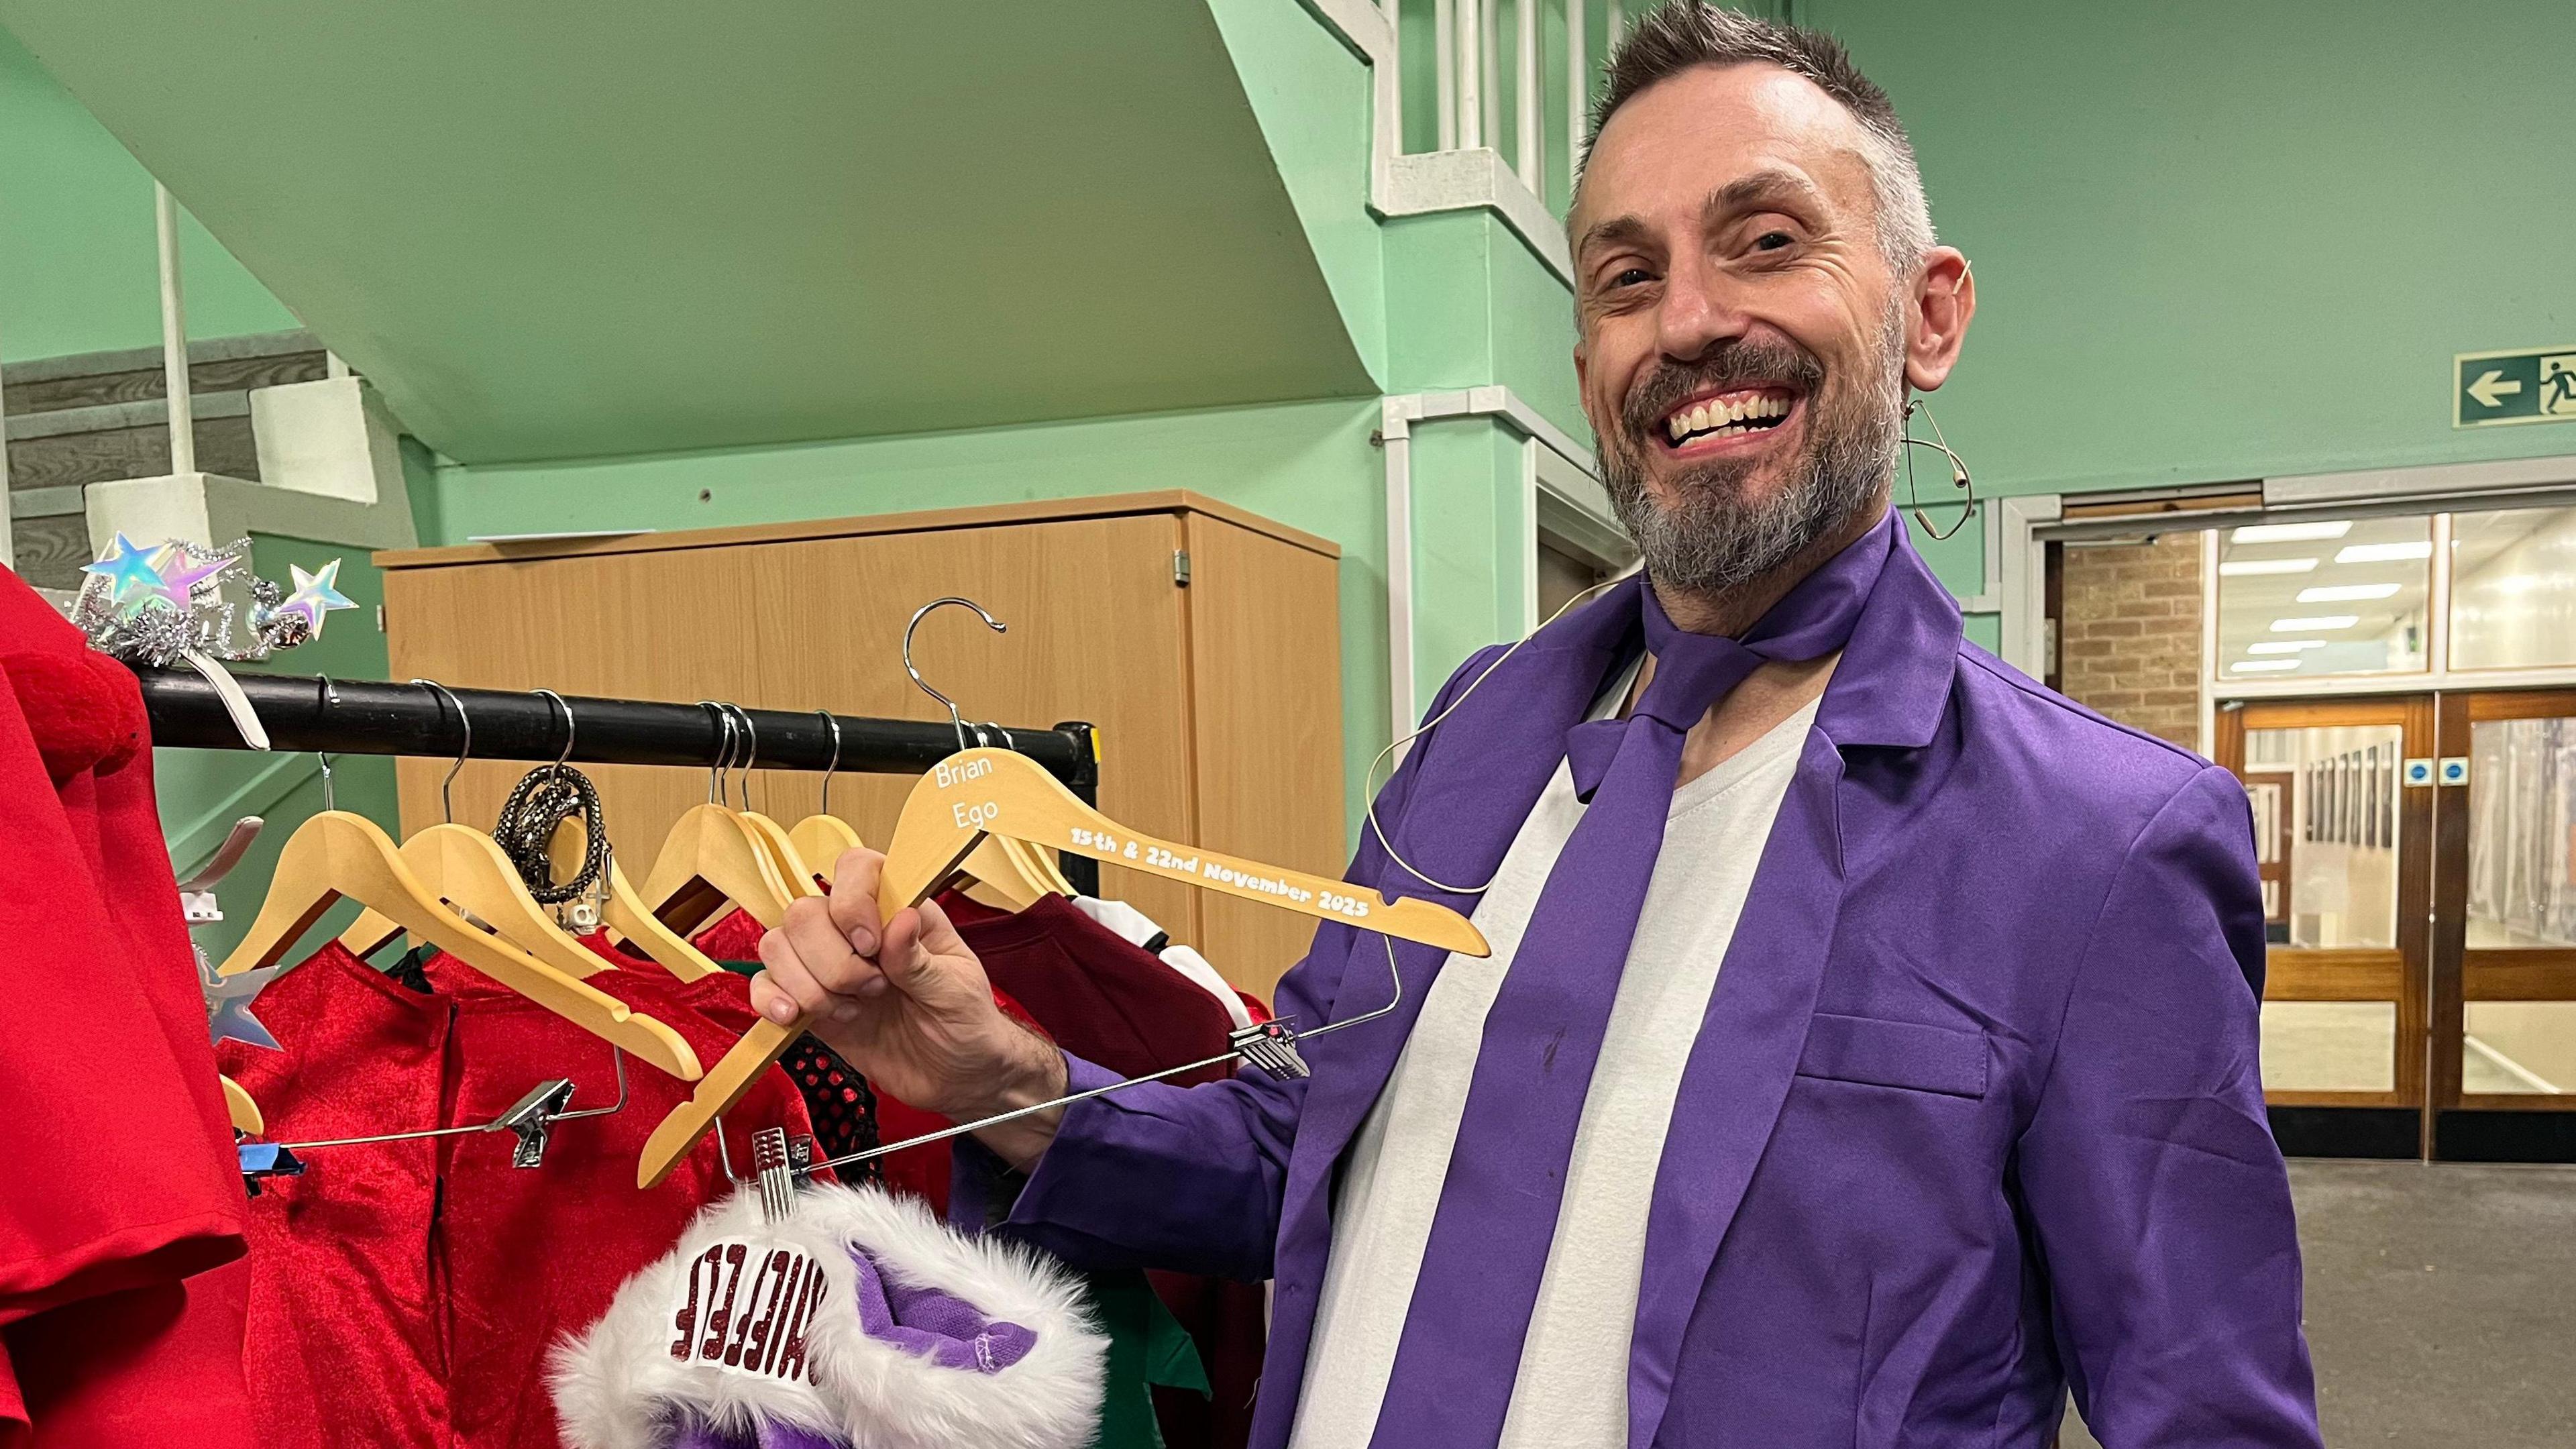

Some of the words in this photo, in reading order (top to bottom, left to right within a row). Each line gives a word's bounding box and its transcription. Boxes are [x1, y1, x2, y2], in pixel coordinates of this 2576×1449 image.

[935, 757, 993, 788] Brian
[953, 802, 998, 830] Ego
[1071, 828, 1117, 853] 15th
[1123, 841, 1138, 859] &
[1146, 847, 1199, 873] 22nd
[1203, 862, 1312, 902] November
[1318, 891, 1369, 917] 2025
[724, 1248, 828, 1386] HIEF
